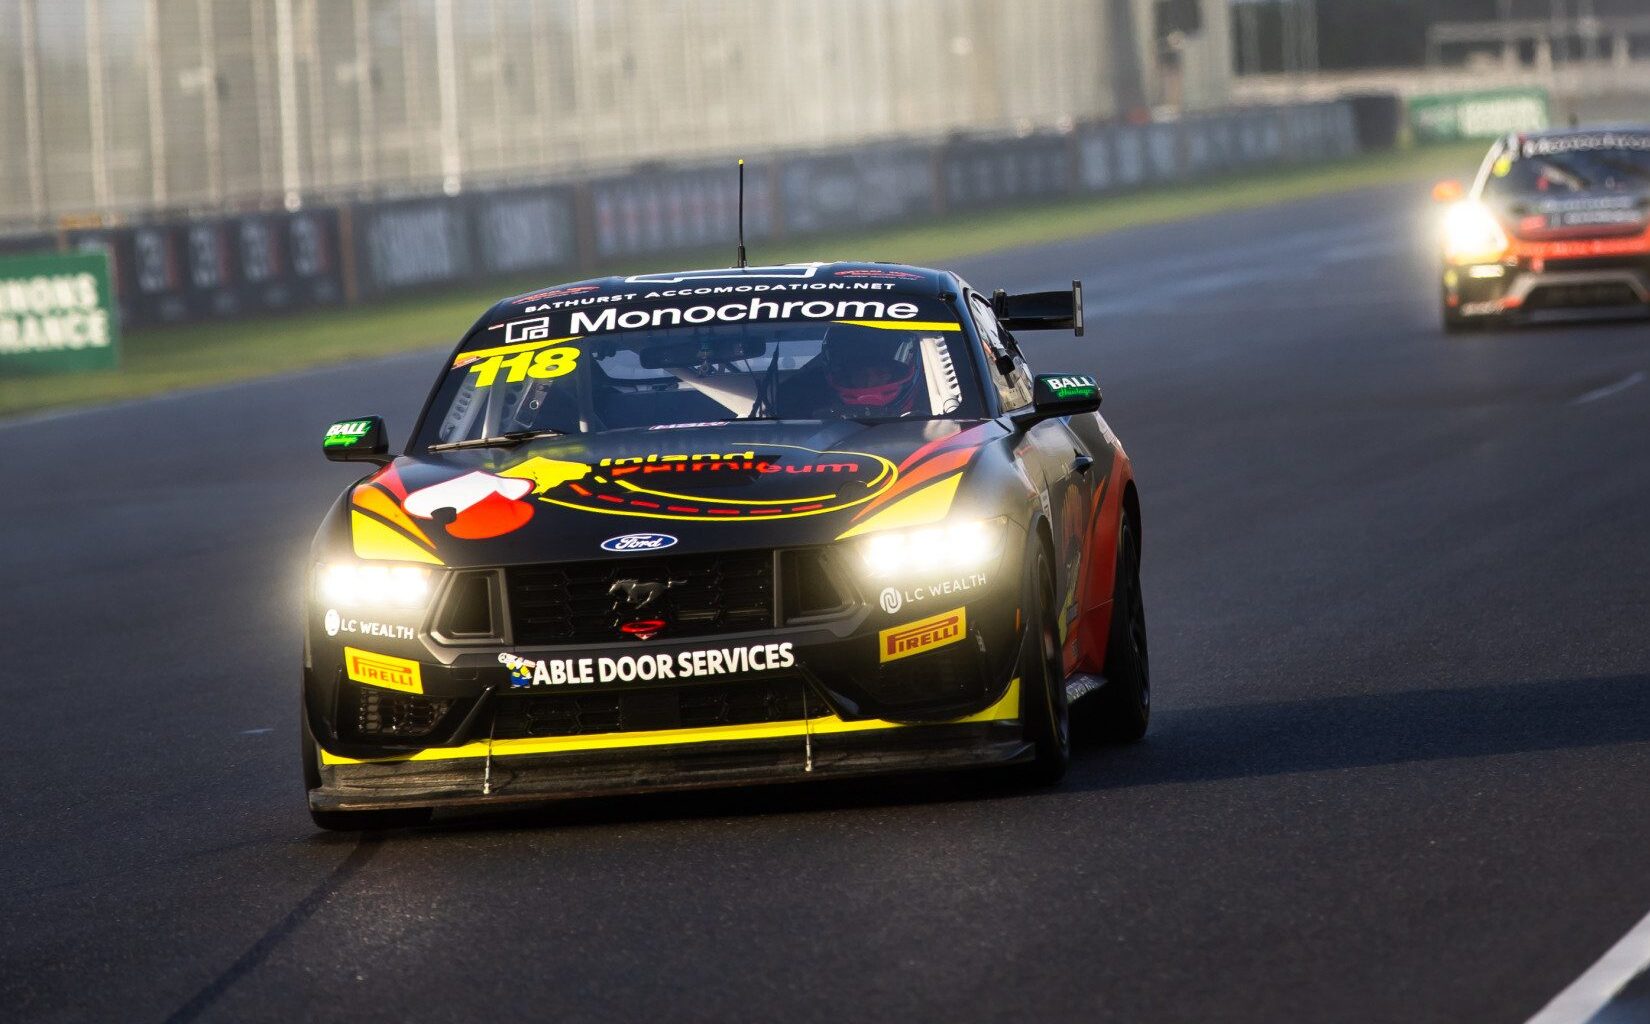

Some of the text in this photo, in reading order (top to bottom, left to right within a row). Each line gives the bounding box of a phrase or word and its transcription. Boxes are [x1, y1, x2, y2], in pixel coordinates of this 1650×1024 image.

[524, 293, 637, 313] BATHURST
[644, 283, 896, 299] ACCOMODATION.NET
[569, 298, 919, 335] Monochrome
[469, 346, 581, 387] 118
[1047, 376, 1095, 390] BALL
[326, 421, 368, 436] BALL
[614, 535, 664, 550] Ford
[905, 573, 986, 603] LC WEALTH
[341, 618, 414, 640] LC WEALTH
[886, 615, 959, 656] PIRELLI
[352, 655, 414, 687] PIRELLI
[532, 659, 594, 686] ABLE
[598, 654, 676, 683] DOOR
[678, 642, 795, 678] SERVICES
